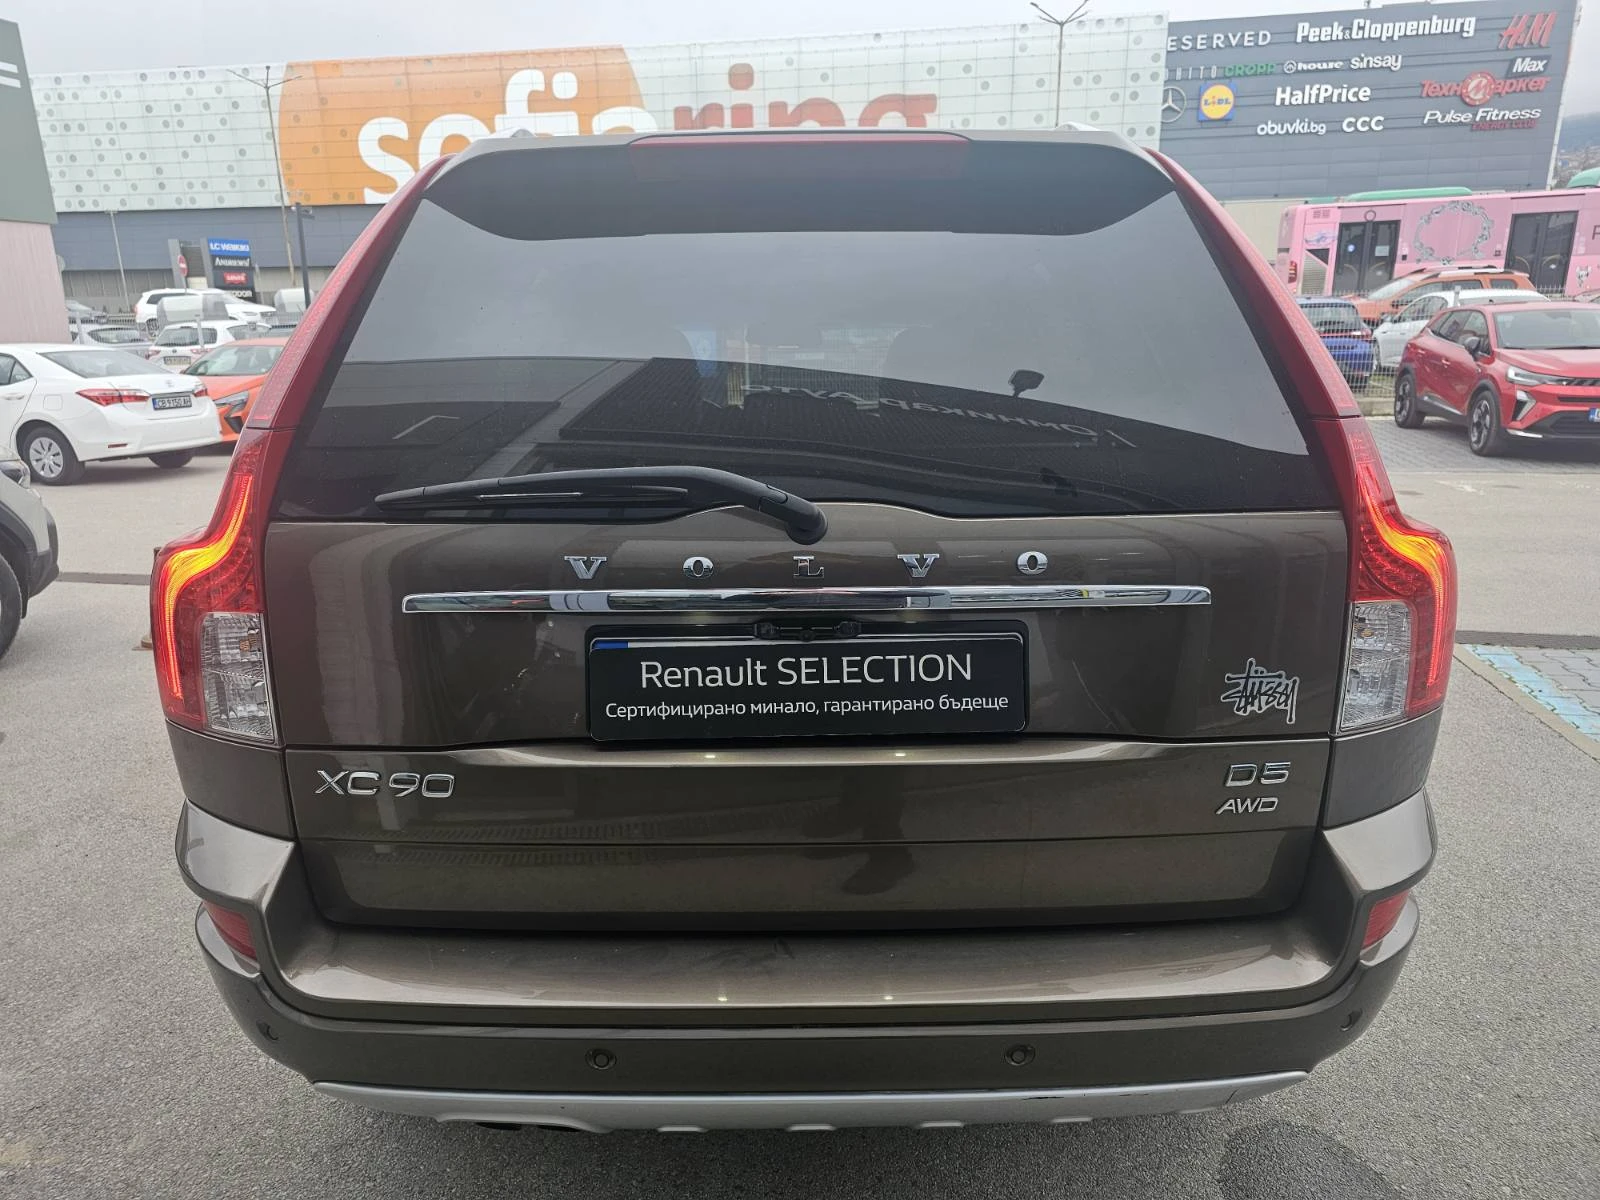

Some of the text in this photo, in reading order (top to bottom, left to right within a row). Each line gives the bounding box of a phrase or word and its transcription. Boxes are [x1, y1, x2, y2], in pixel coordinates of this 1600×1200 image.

[1497, 12, 1558, 49] H&M
[1224, 63, 1277, 77] CROPP
[1350, 53, 1402, 72] sinsay
[1512, 57, 1547, 74] Max
[1275, 83, 1372, 106] HalfPrice
[1257, 117, 1327, 136] obuvki.bg
[1342, 116, 1384, 133] CCC
[1423, 107, 1542, 125] Pulse Fitness
[564, 551, 1049, 580] VOLVO
[640, 653, 973, 690] Renault SELECTION
[605, 692, 1009, 722] Сертифицирано минало, гарантирано бъдеще
[314, 770, 456, 798] XC 90
[1225, 762, 1291, 788] D5
[1216, 797, 1279, 815] AWD
